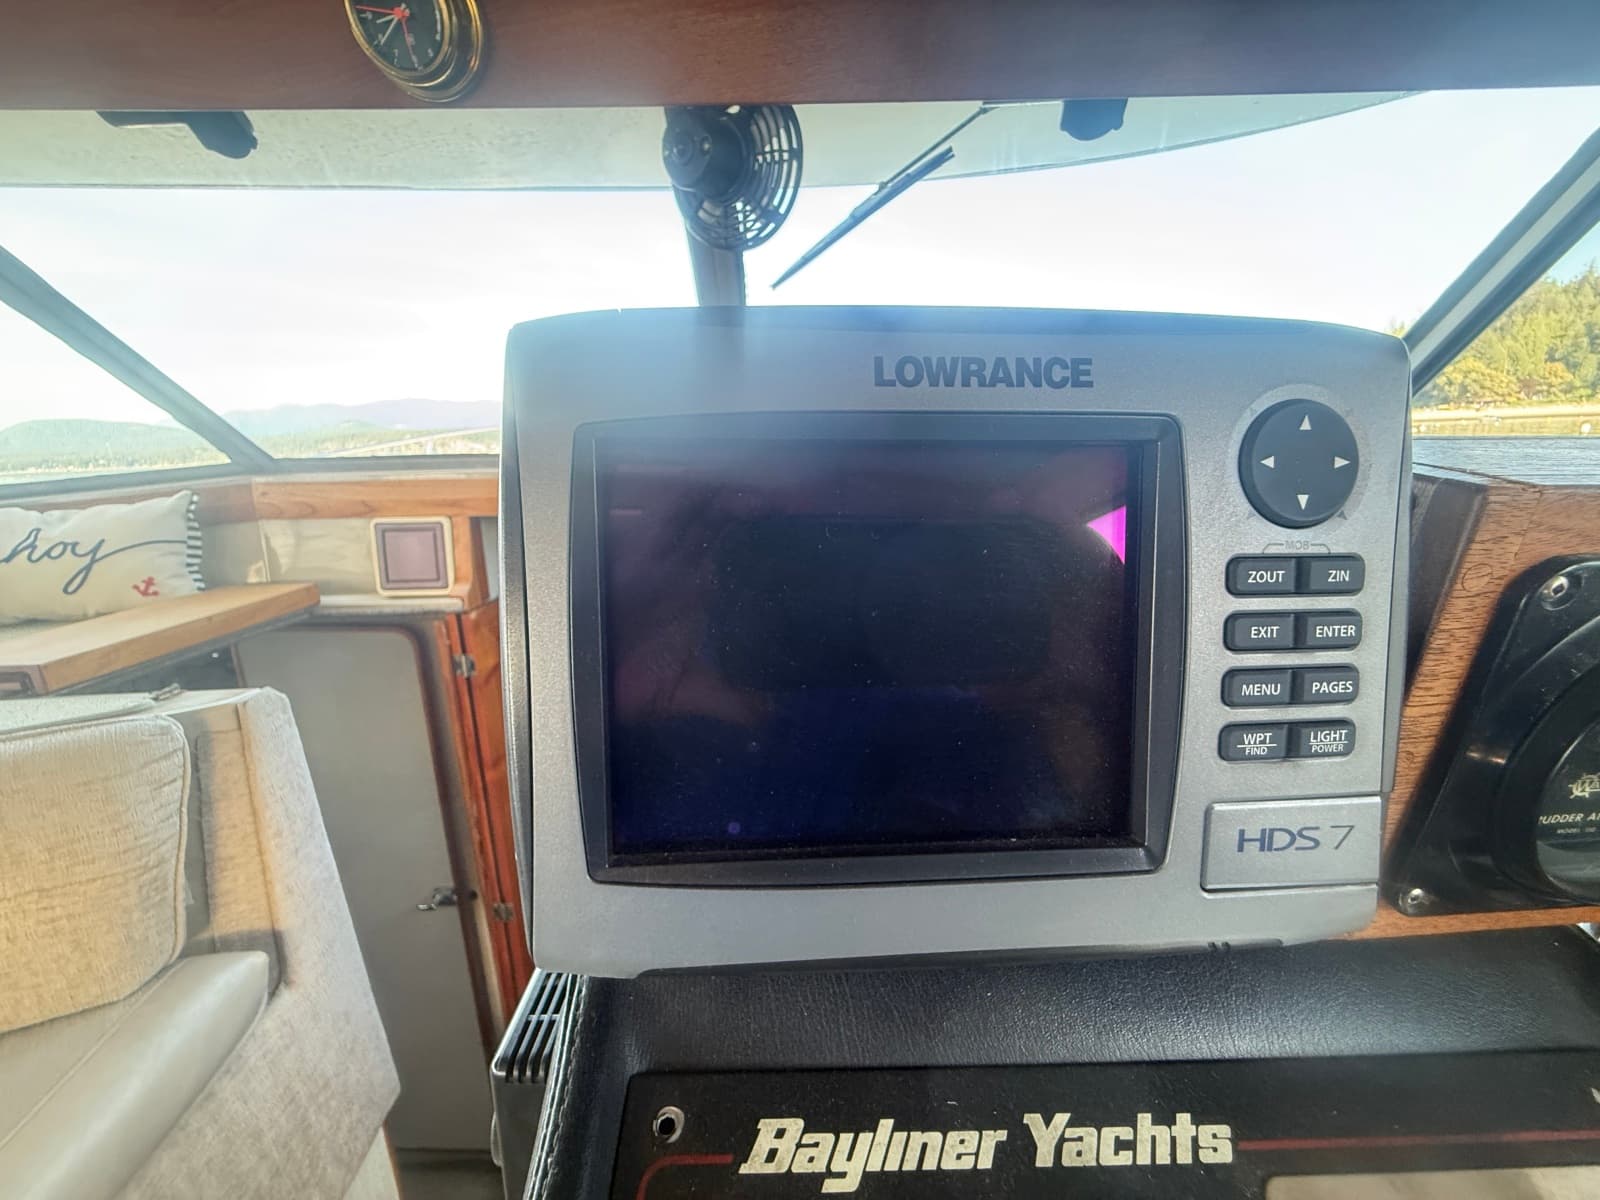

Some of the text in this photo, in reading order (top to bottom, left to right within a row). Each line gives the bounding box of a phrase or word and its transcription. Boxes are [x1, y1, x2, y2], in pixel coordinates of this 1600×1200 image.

[873, 355, 1094, 389] LOWRANCE
[1247, 570, 1286, 583] ZOUT
[1327, 570, 1350, 582] ZIN
[1250, 626, 1280, 639] EXIT
[1315, 625, 1356, 637] ENTER
[1241, 683, 1281, 696] MENU
[1311, 681, 1353, 693] PAGES
[1243, 733, 1272, 745] WPT
[1310, 730, 1348, 742] LIGHT
[1245, 747, 1268, 756] FIND
[1311, 743, 1344, 753] POWER
[1237, 824, 1355, 852] HDS 7
[738, 1112, 1234, 1194] Bayliner Yachts
